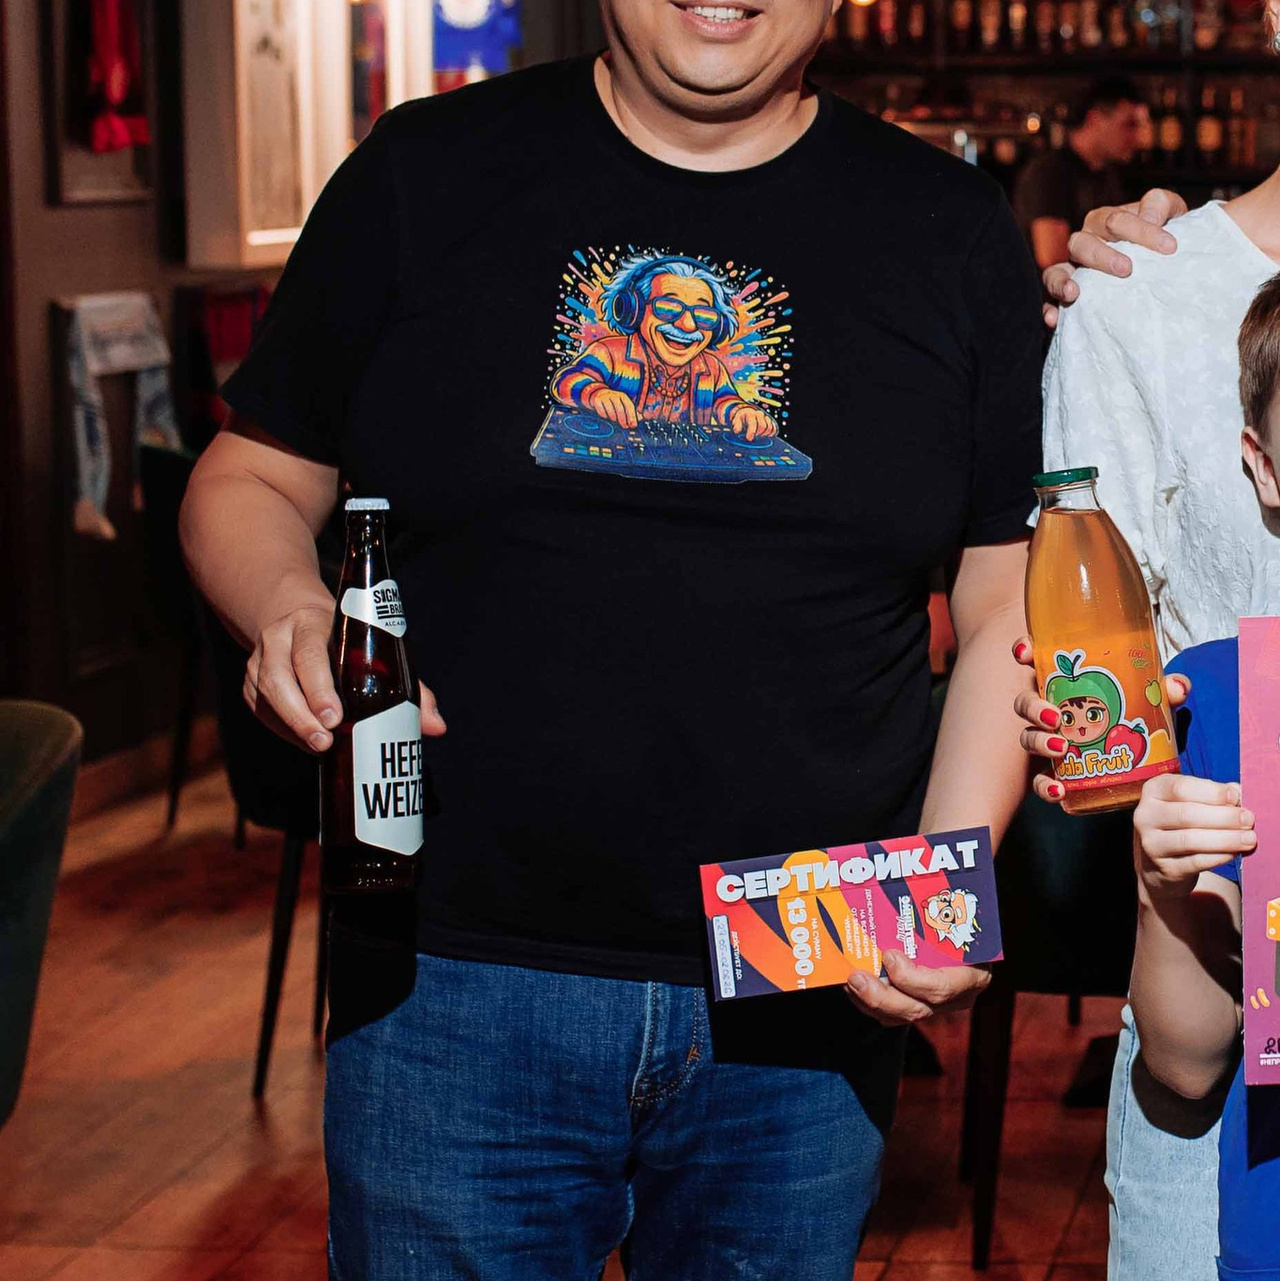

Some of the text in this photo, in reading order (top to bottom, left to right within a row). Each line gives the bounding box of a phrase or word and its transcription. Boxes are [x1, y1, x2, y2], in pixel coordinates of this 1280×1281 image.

[1085, 747, 1130, 774] Fruit
[716, 839, 979, 903] СЕРТИФИКАТ
[787, 897, 807, 924] 13
[790, 926, 814, 976] 000
[811, 918, 822, 960] НА СУММУ
